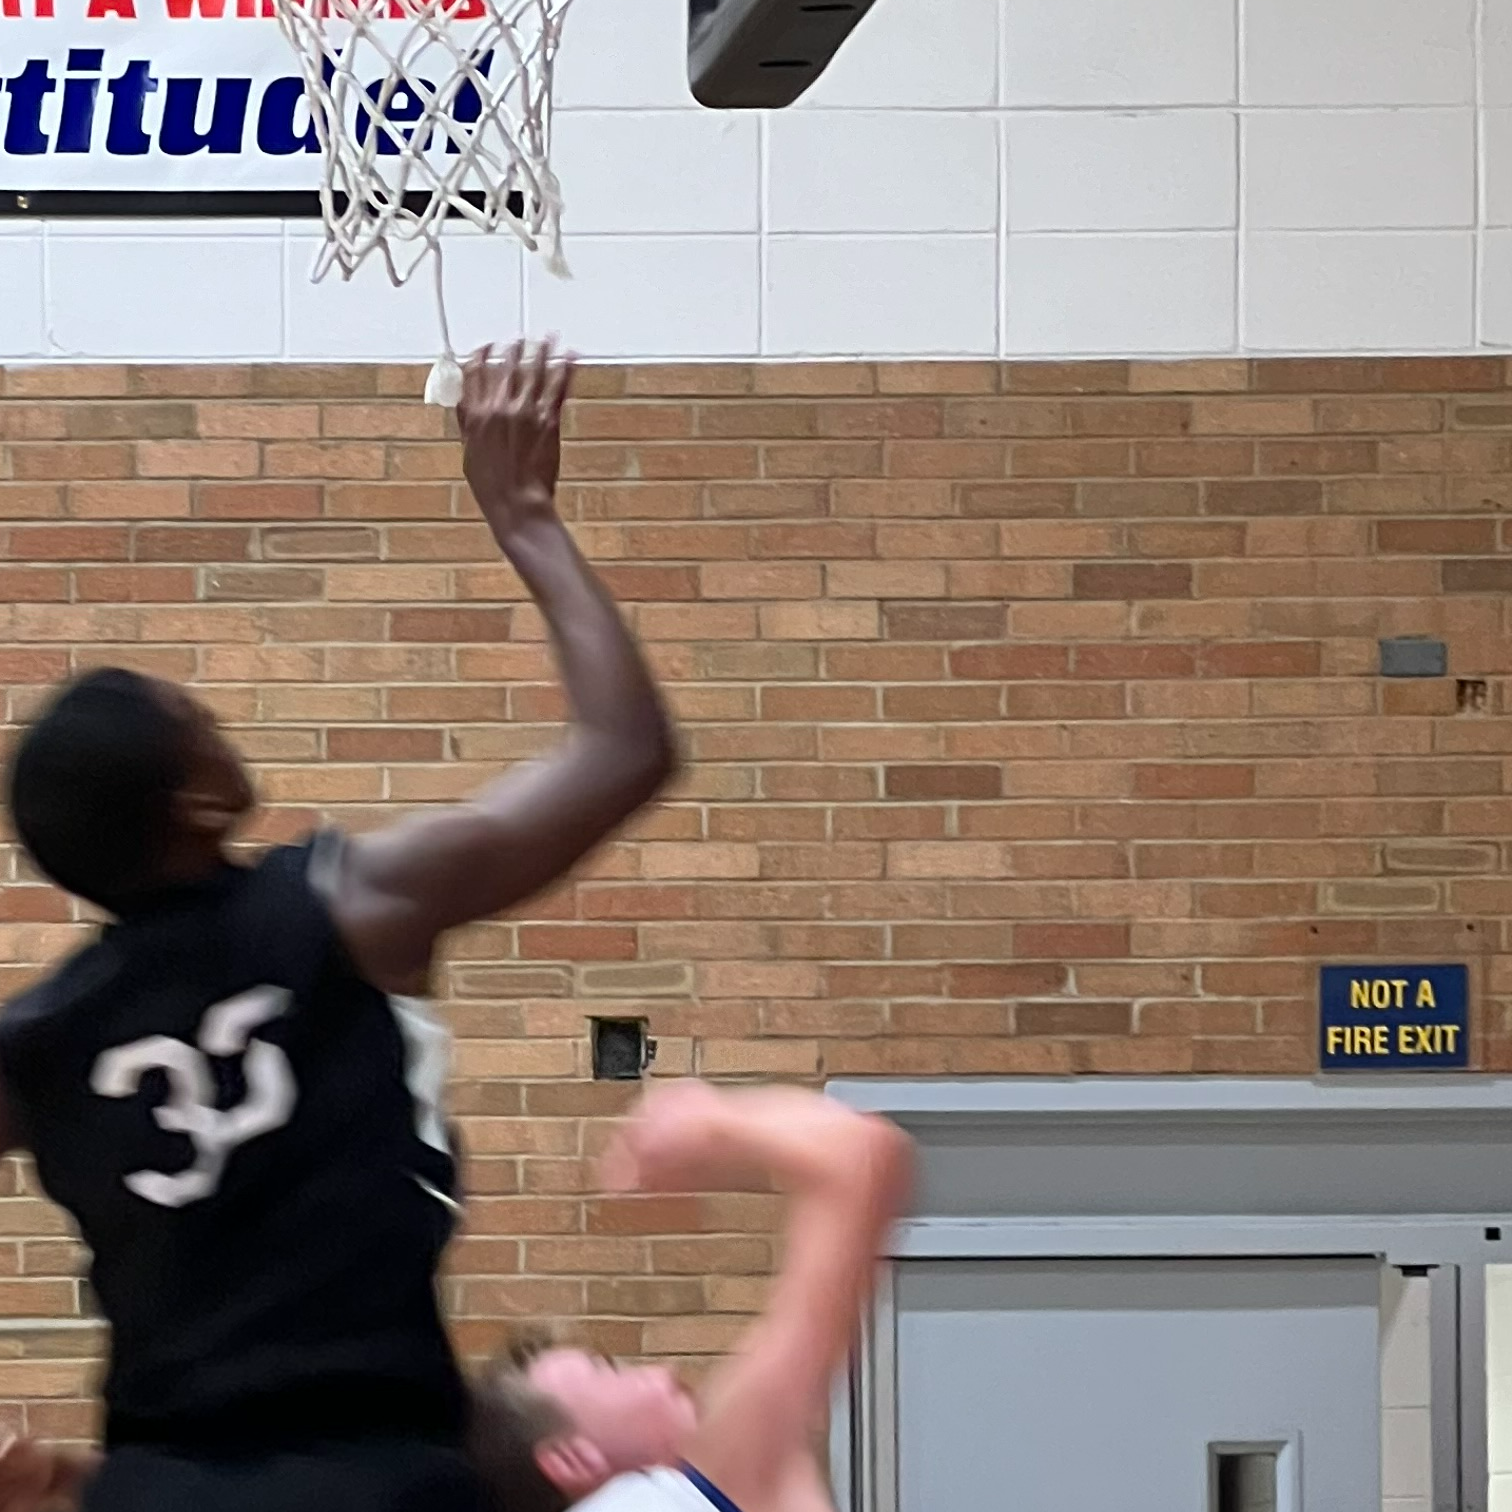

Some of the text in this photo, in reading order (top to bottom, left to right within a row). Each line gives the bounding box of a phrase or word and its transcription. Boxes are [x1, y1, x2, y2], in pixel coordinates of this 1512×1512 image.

[1350, 979, 1436, 1009] NOT A
[1326, 1024, 1461, 1055] FIRE EXIT
